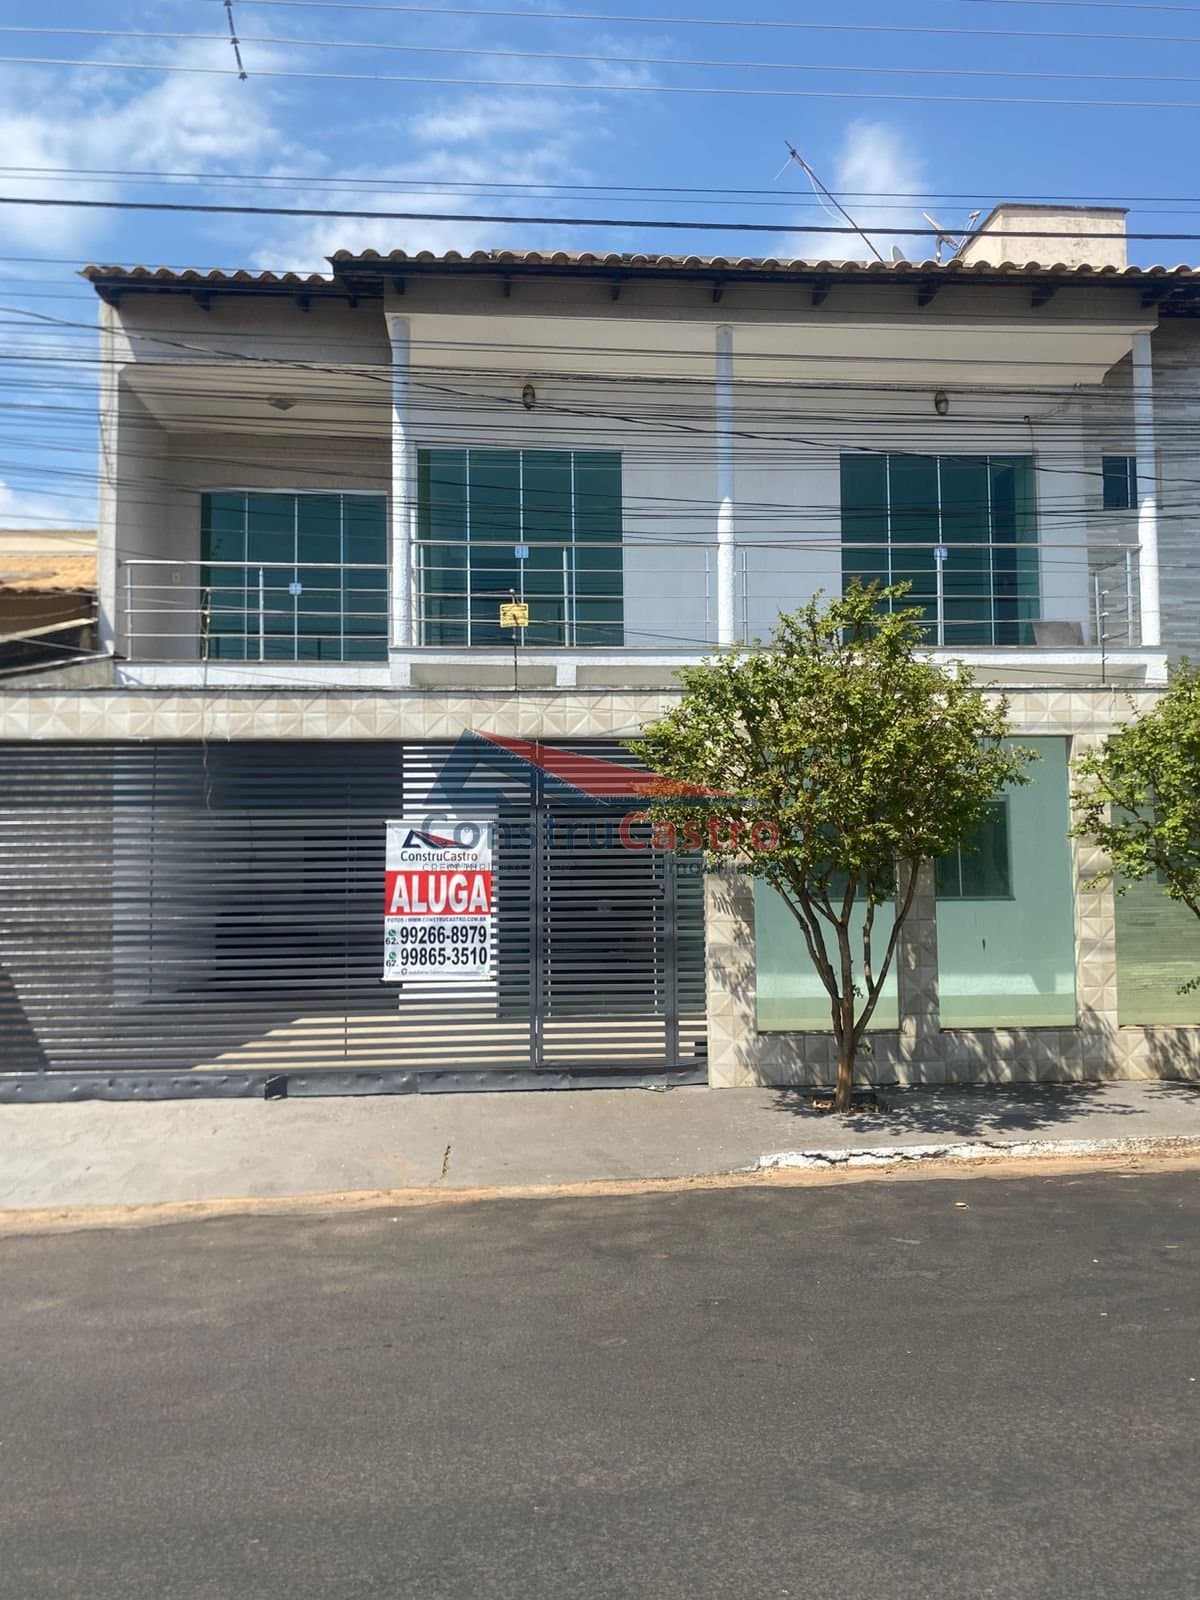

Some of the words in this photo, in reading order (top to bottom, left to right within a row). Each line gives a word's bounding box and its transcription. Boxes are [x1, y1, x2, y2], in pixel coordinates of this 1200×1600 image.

[400, 850, 478, 862] ConstruCastro
[389, 874, 489, 913] ALUGA
[400, 925, 487, 945] 99266-8979
[400, 946, 487, 966] 99865-3510
